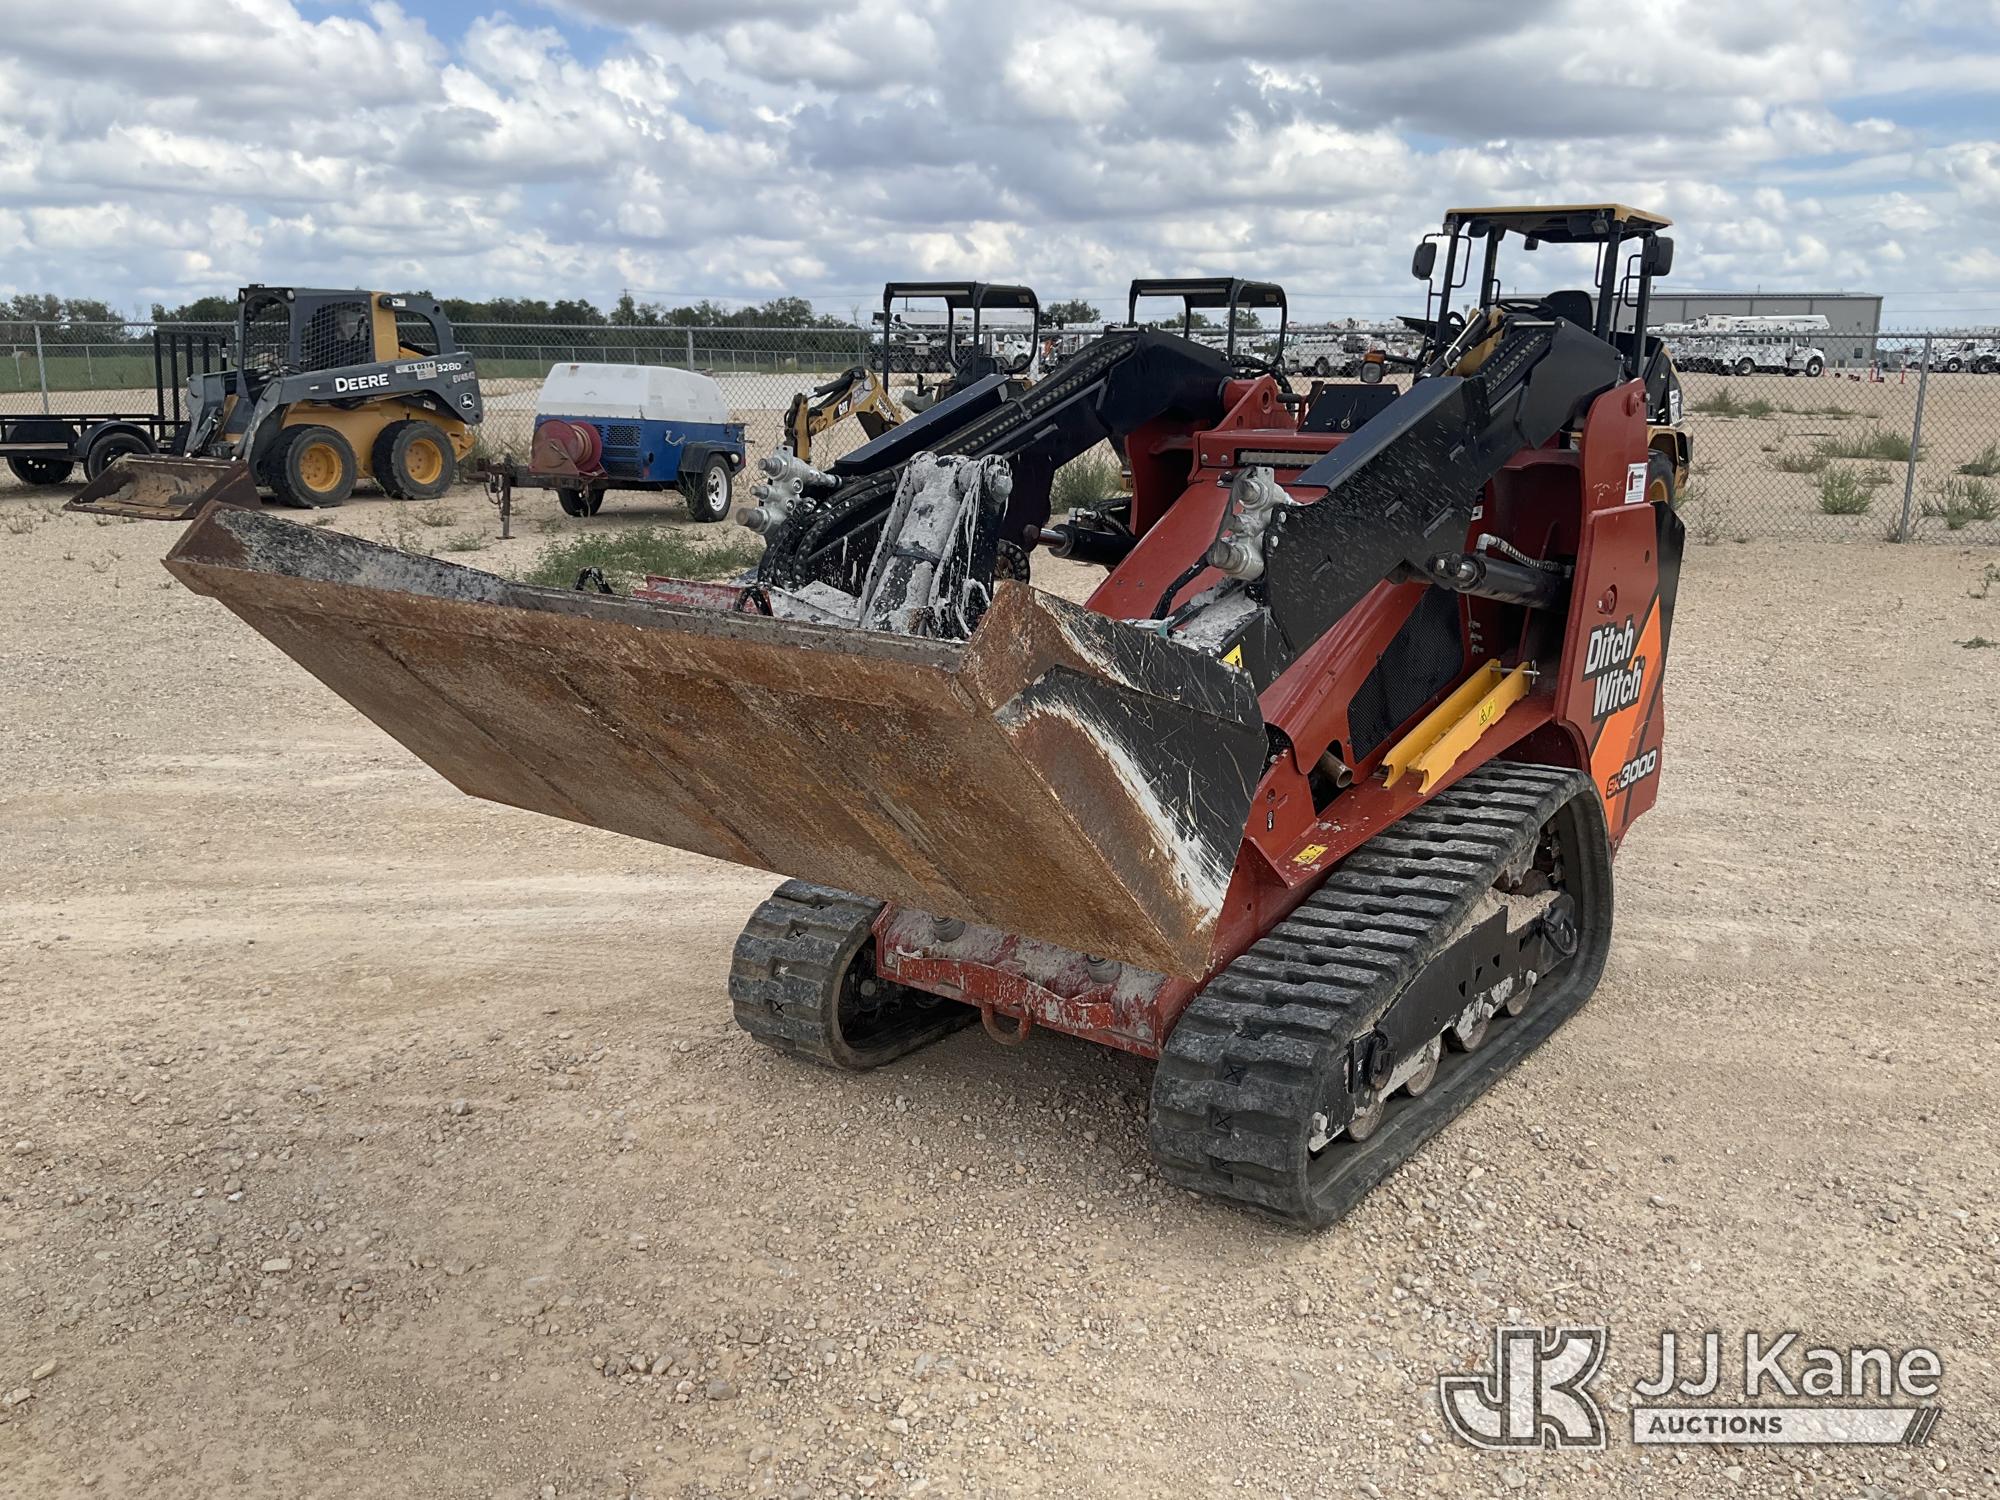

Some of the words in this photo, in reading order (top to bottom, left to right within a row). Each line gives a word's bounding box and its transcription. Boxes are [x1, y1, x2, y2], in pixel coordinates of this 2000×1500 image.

[335, 374, 389, 392] DEERE
[436, 362, 462, 372] 328D
[1584, 619, 1634, 675] Ditch
[1593, 661, 1643, 717] Witch
